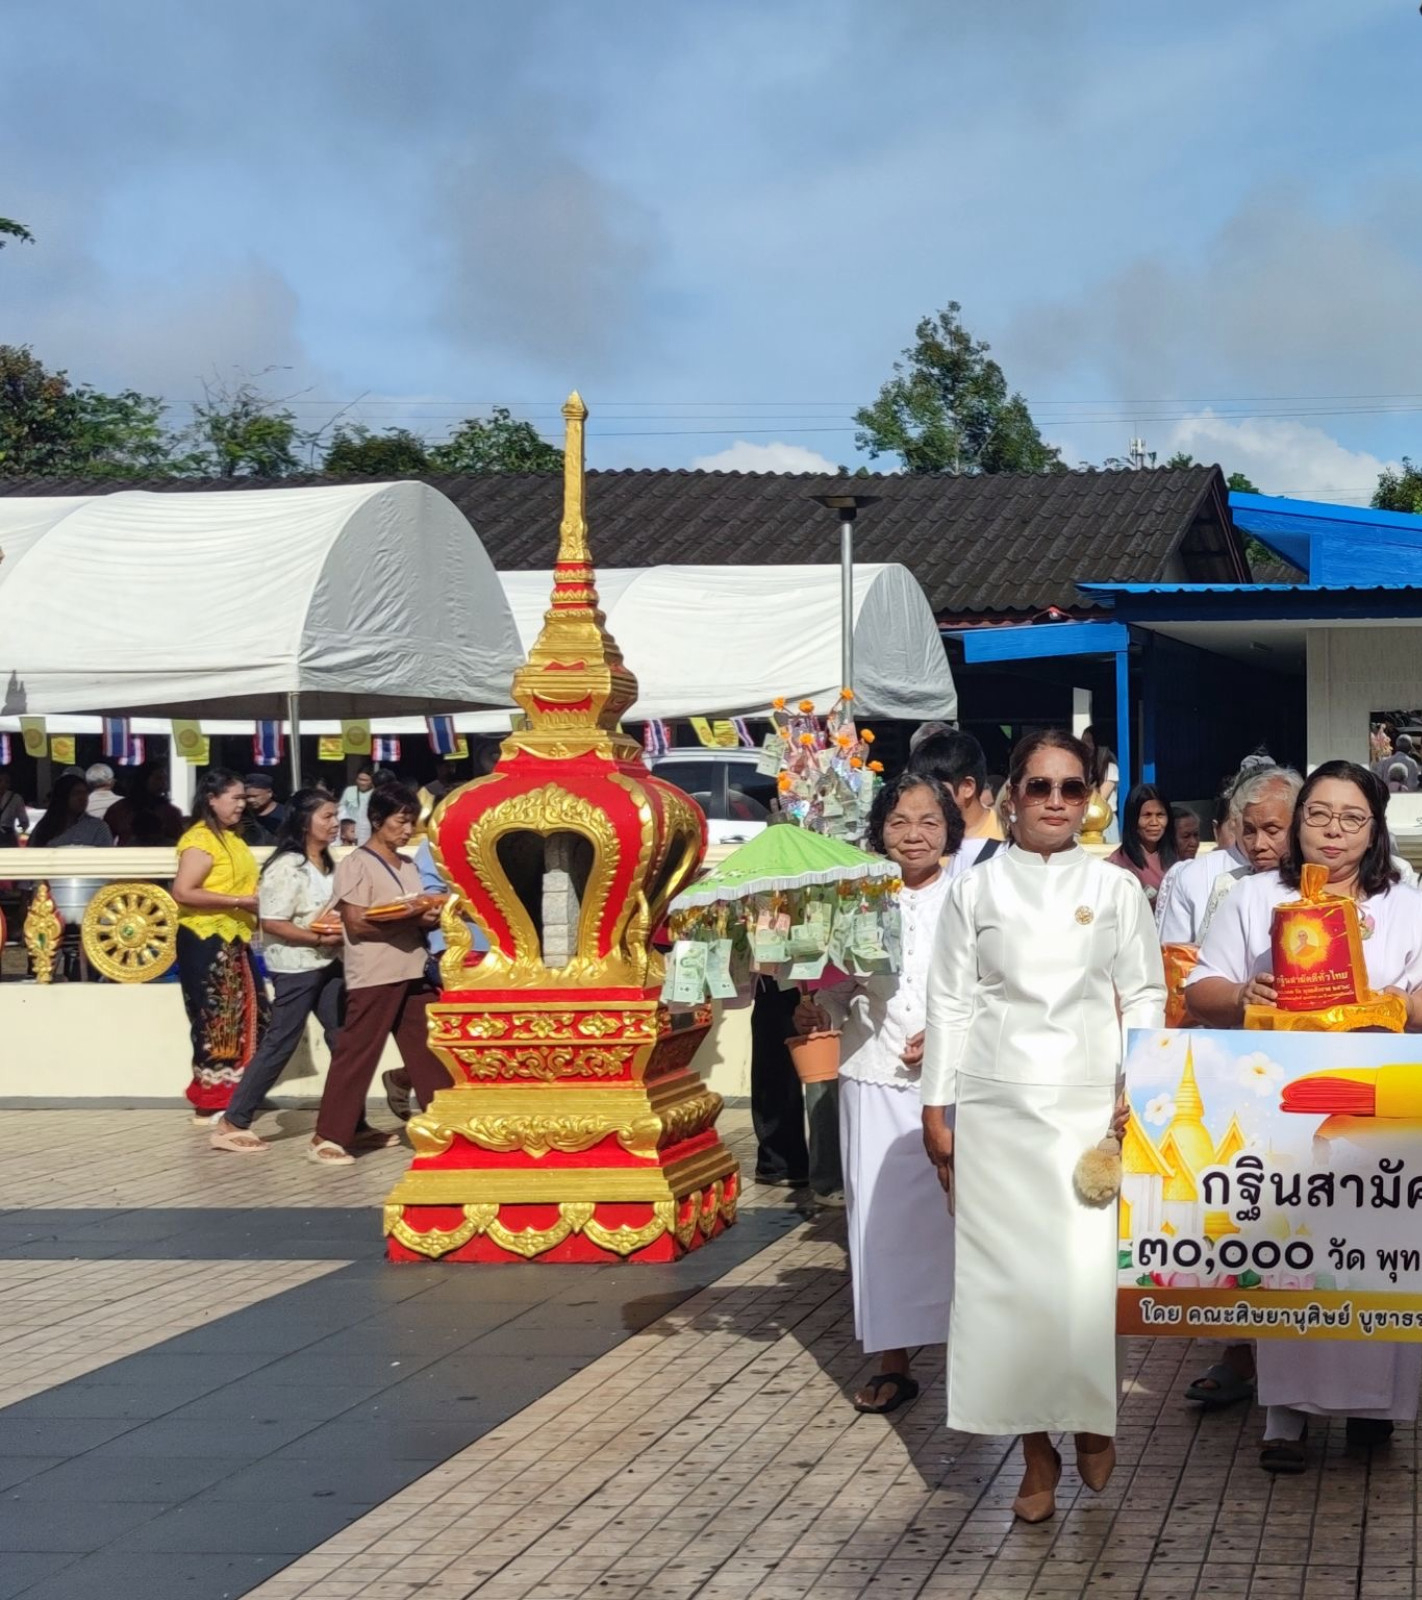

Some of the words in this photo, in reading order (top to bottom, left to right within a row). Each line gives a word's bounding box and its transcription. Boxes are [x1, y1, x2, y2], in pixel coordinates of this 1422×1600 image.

[1138, 1238, 1314, 1275] ๓๐,๐๐๐
[1328, 1237, 1365, 1270] วัด
[1141, 1300, 1180, 1322] โดย
[1189, 1304, 1350, 1332] คณะศิษยานุศิษย์
